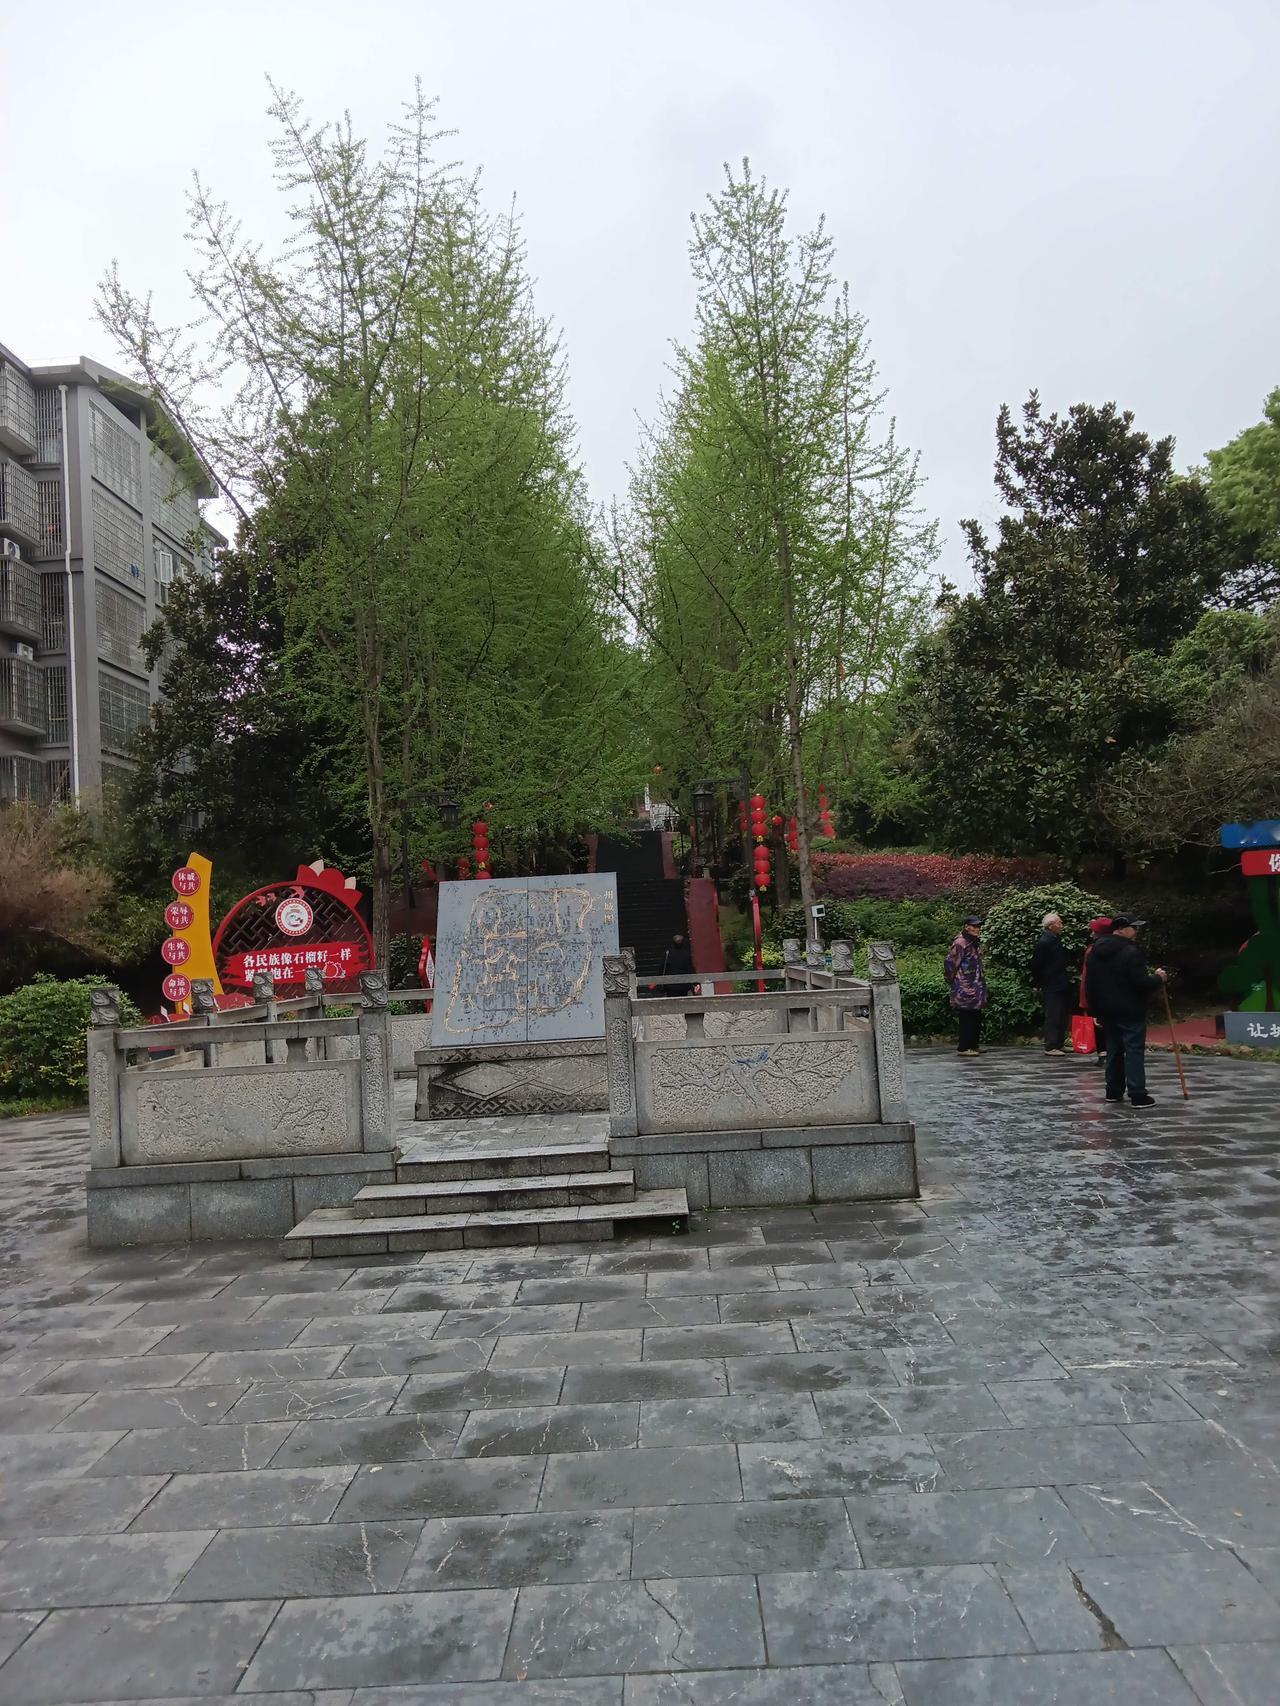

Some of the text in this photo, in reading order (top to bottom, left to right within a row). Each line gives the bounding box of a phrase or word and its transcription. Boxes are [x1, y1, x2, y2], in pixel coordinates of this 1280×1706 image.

[179, 881, 195, 890] 与共
[172, 915, 189, 924] 与共
[167, 942, 185, 950] 生死
[168, 950, 186, 960] 与共
[243, 948, 352, 967] 各民族像石榴籽一样
[169, 986, 186, 996] 与共
